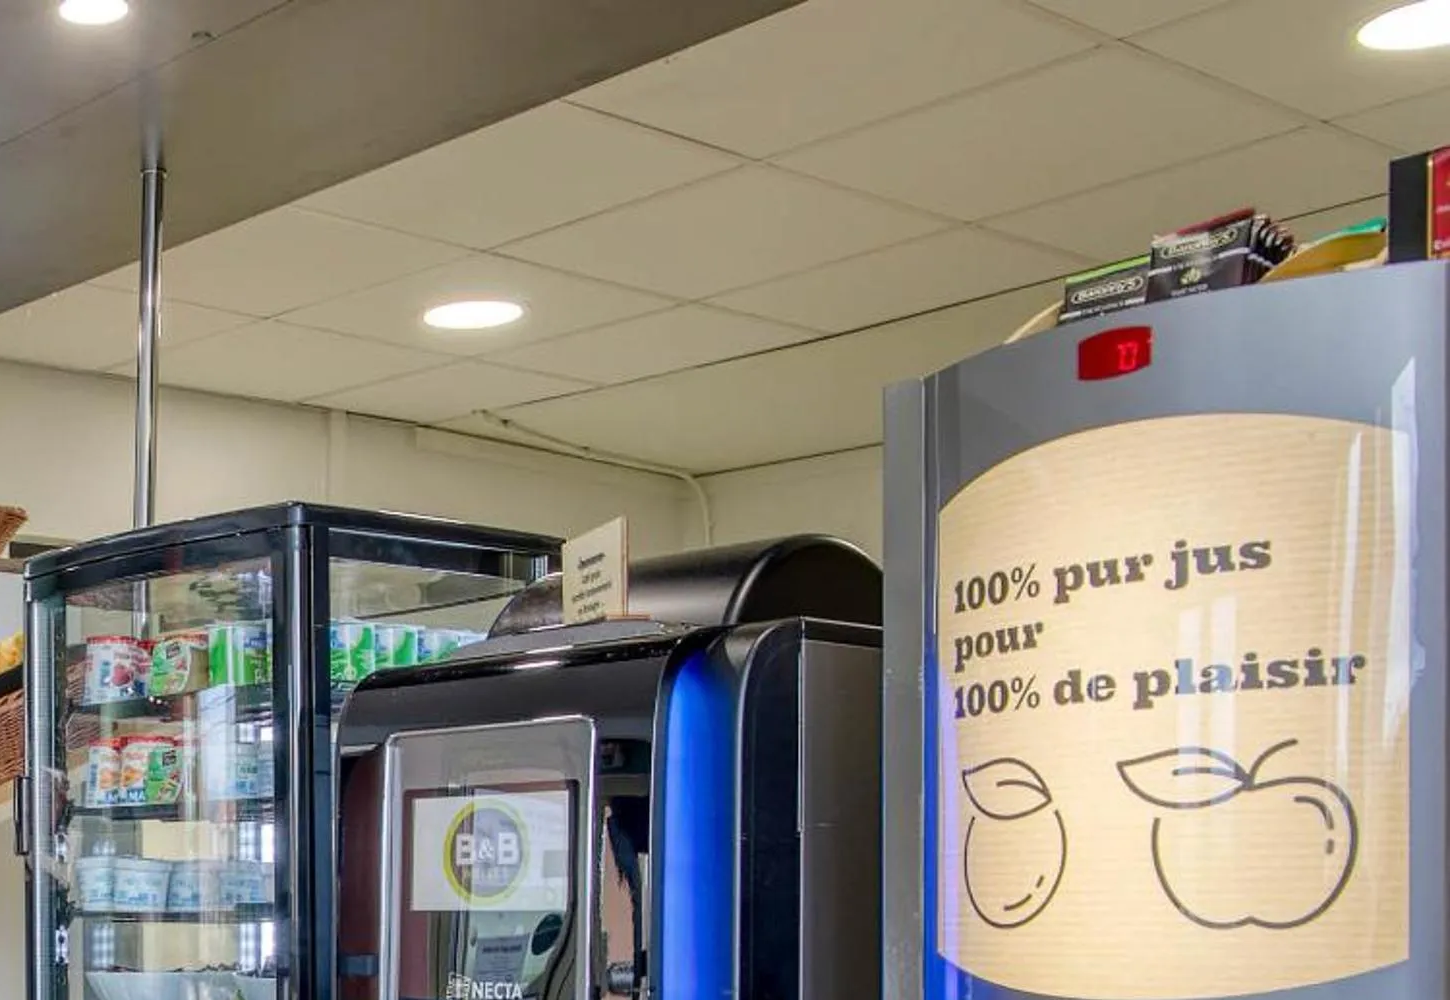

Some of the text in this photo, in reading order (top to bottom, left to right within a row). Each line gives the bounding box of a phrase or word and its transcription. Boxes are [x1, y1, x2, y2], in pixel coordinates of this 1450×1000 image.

[954, 540, 1272, 614] 100% pur jus
[954, 621, 1044, 673] pour
[954, 648, 1367, 720] 100% de plaisir
[456, 832, 520, 865] B&B
[471, 981, 524, 1000] NECTA
